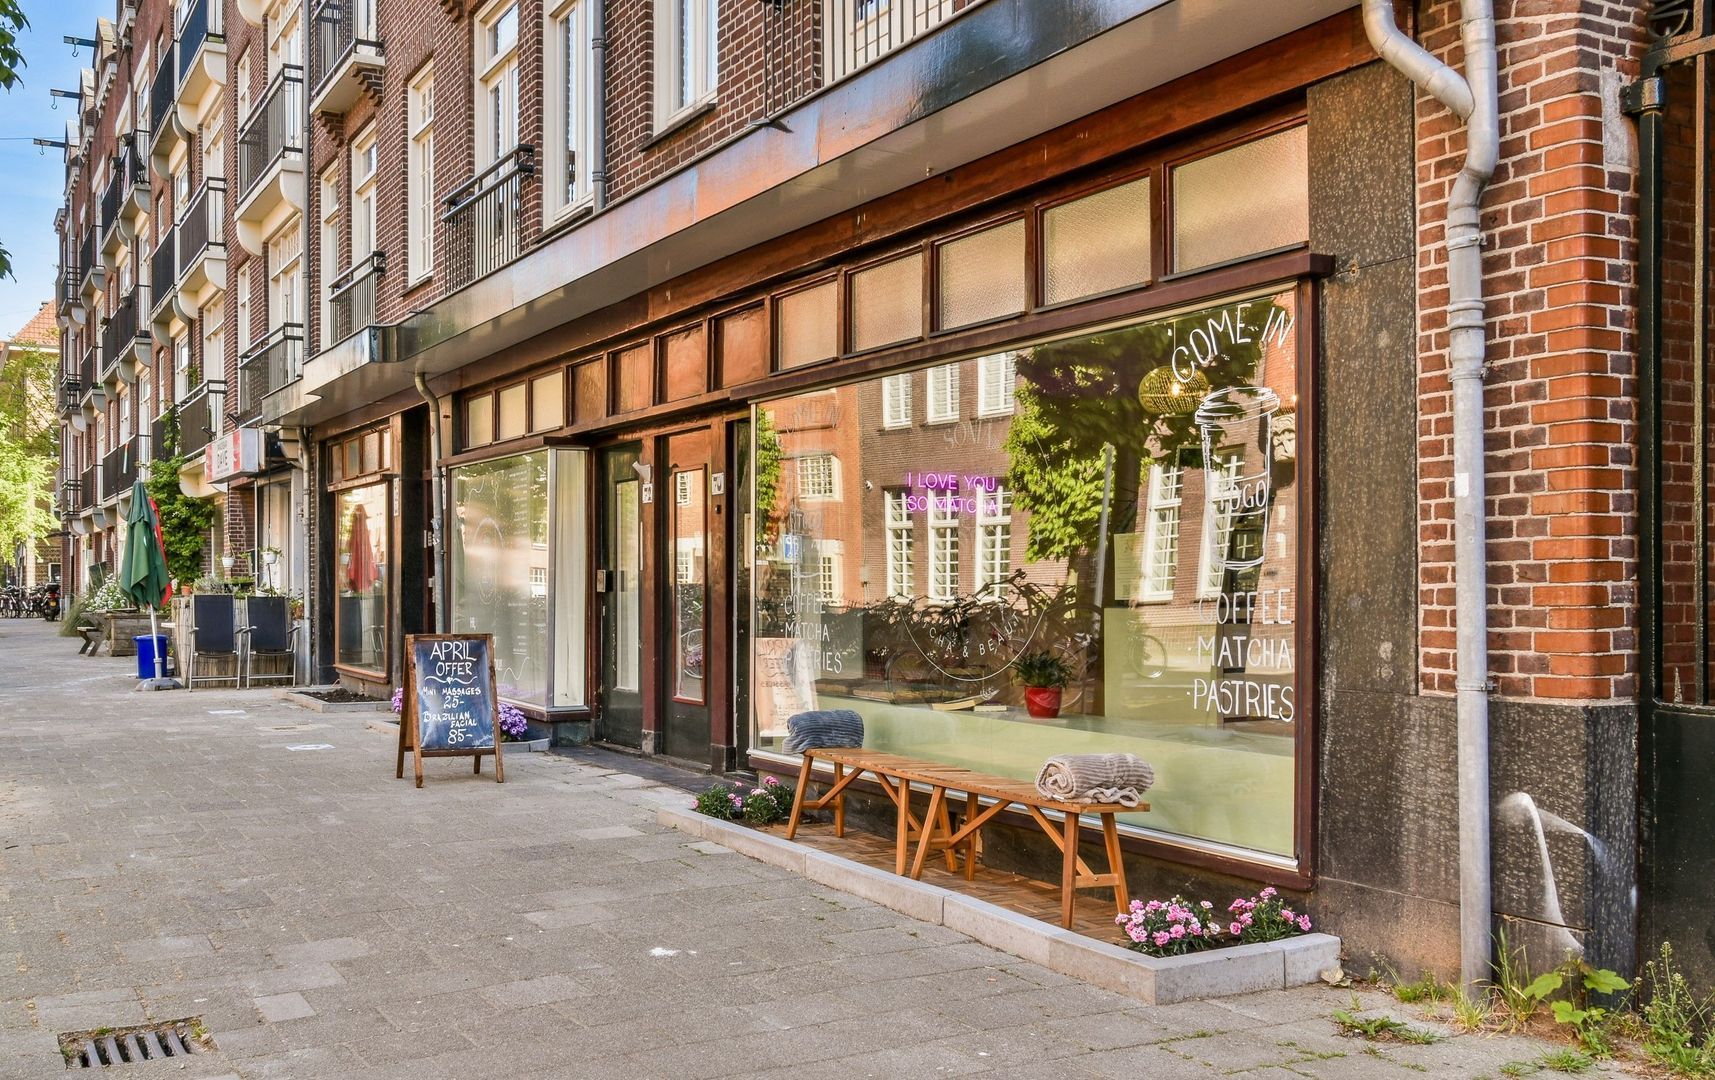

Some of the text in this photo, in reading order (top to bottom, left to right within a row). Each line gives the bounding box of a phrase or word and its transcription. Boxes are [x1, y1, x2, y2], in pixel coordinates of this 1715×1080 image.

[1172, 303, 1295, 383] COME IN
[907, 472, 996, 491] I LOVE YOU
[907, 496, 998, 514] SO MATCHA
[784, 593, 827, 616] COFFEE
[1198, 588, 1292, 625] COFFEE
[784, 622, 830, 642] MATCHA
[430, 641, 477, 661] APRIL
[784, 648, 842, 674] PATRIES
[962, 645, 969, 658] &
[1197, 635, 1293, 670] MATCHA
[435, 661, 473, 677] OFFER
[442, 687, 481, 696] MASSAGES
[1193, 678, 1294, 722] PASTRIES
[422, 710, 471, 723] BRAZILIAN
[450, 720, 477, 729] FACIAL
